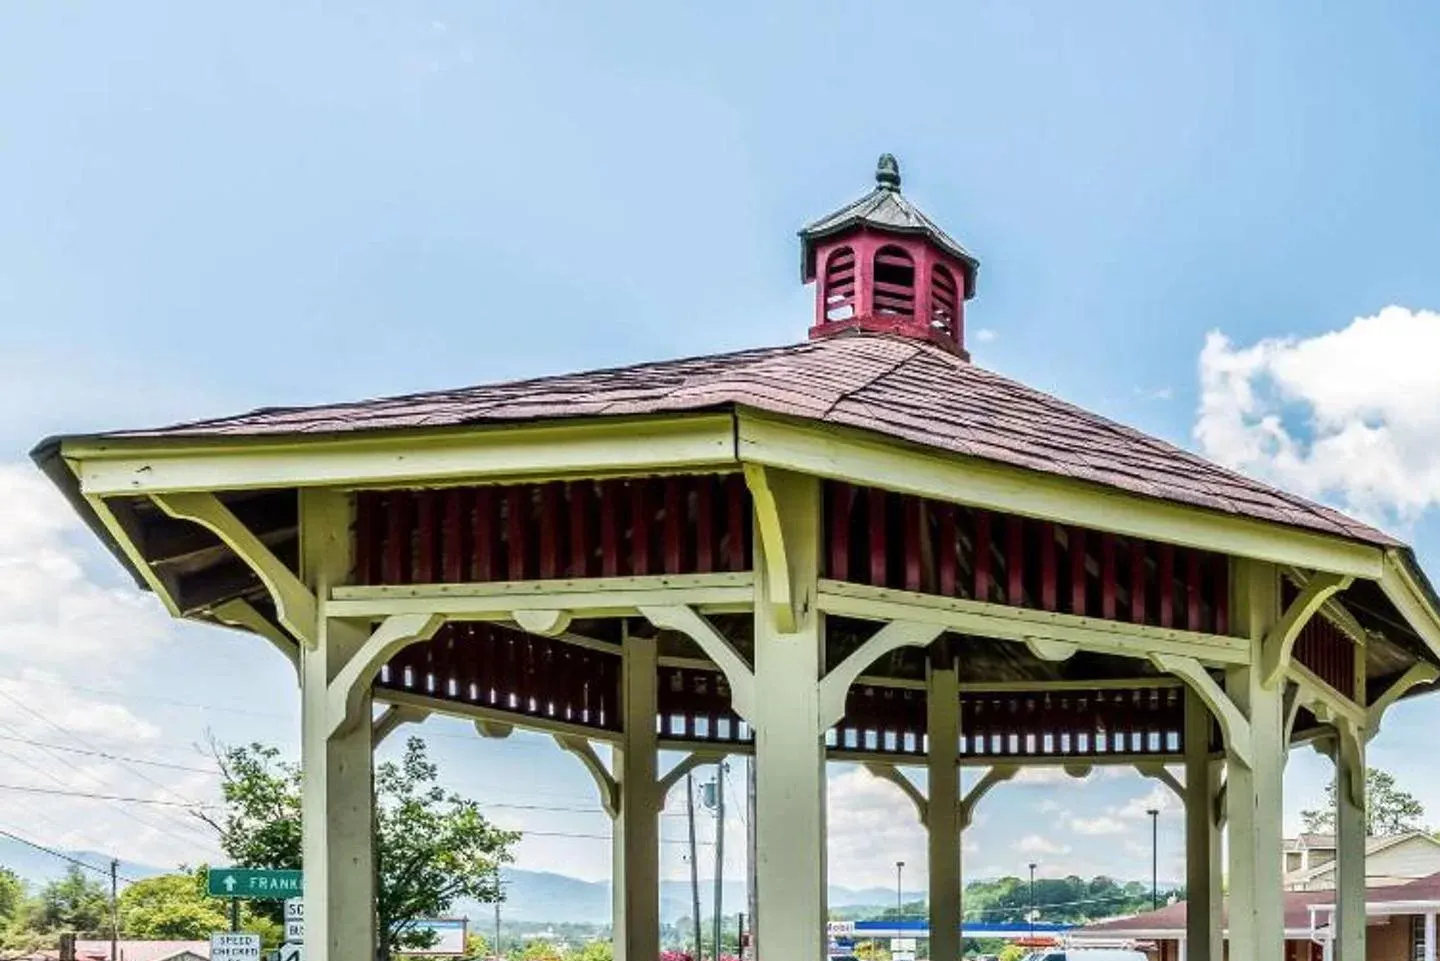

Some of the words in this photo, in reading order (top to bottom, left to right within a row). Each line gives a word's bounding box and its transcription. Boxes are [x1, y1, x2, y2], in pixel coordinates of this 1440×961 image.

[249, 876, 303, 890] FRANK
[220, 936, 253, 945] SPEED
[212, 948, 258, 956] CHECKED
